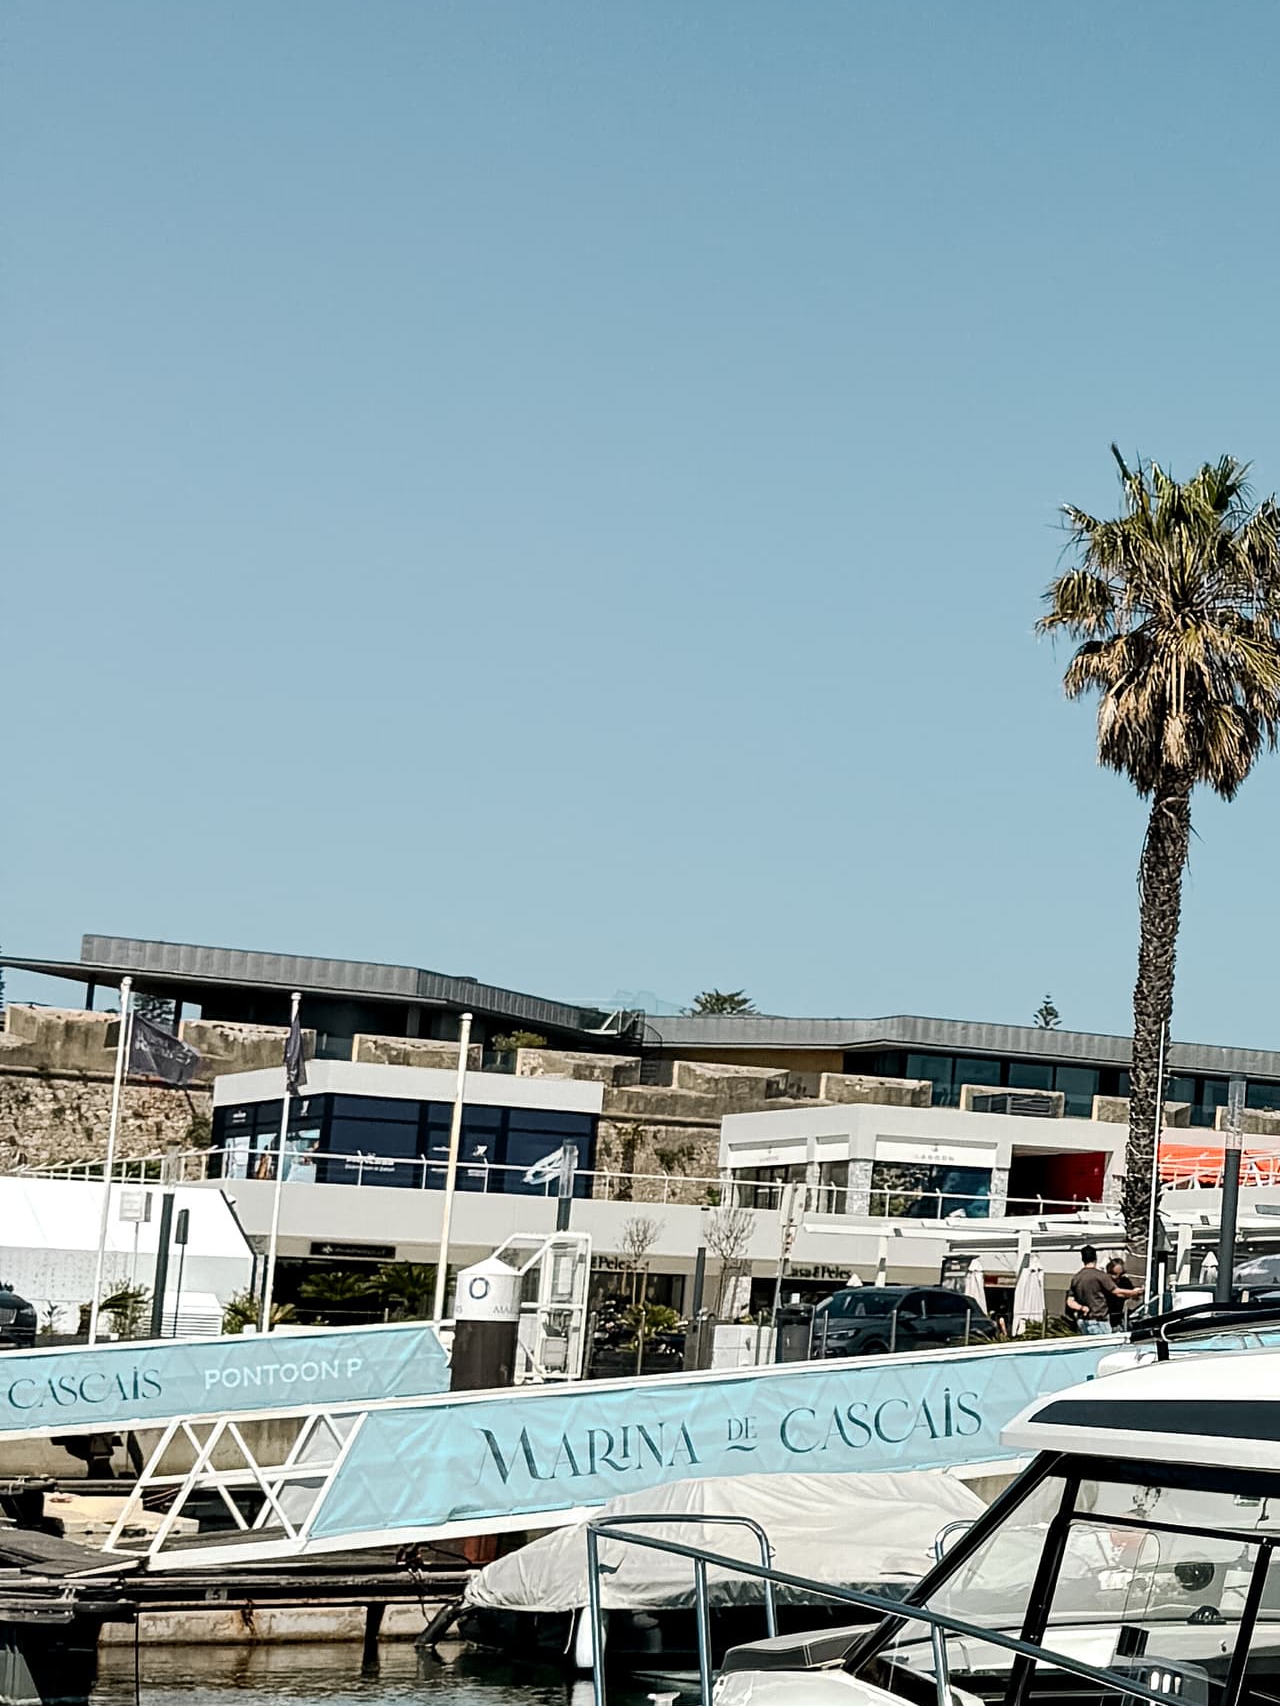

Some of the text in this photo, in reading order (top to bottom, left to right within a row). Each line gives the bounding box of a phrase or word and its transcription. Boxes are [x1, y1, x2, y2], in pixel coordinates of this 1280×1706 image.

[7, 1358, 363, 1410] CASCAIS PONTOON P
[474, 1387, 983, 1486] MARINA DE CASCAIS
